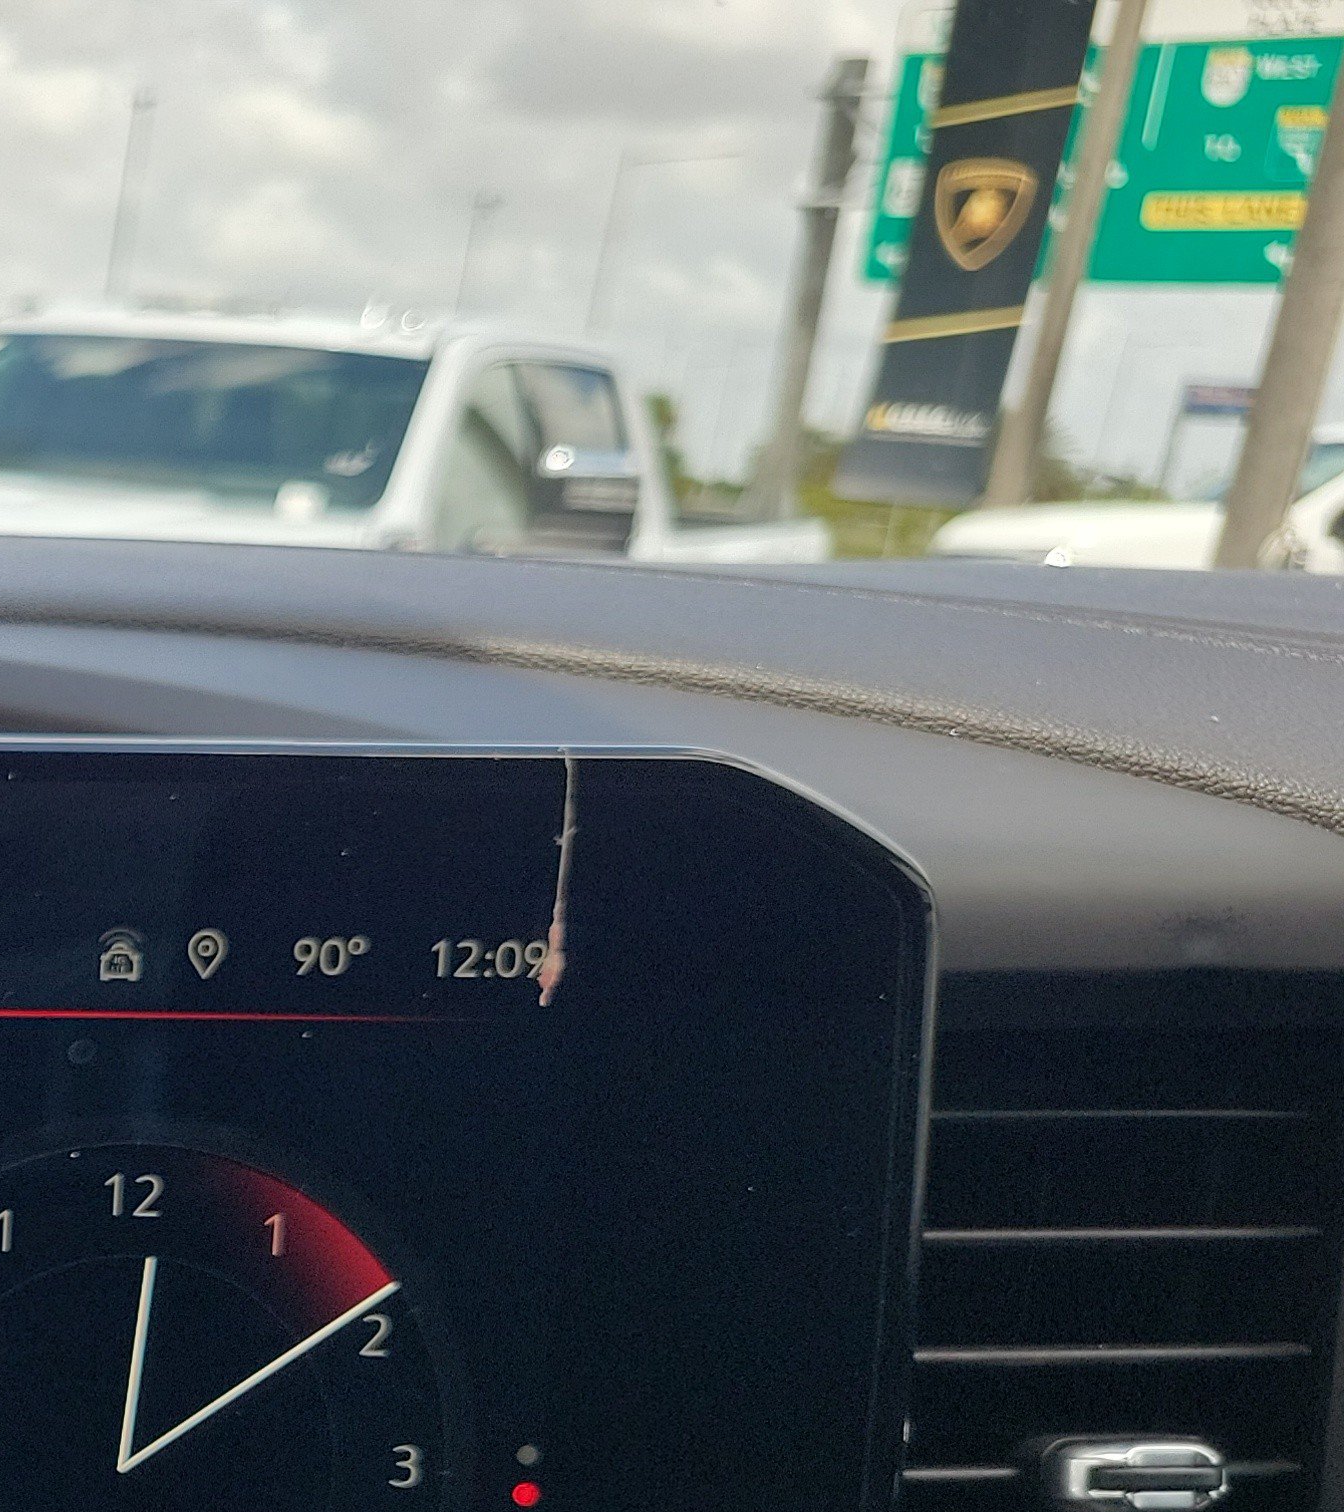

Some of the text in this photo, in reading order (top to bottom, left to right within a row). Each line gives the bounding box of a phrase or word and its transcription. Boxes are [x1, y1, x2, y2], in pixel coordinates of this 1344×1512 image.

[293, 936, 370, 976] 90°
[431, 939, 549, 978] 12:09
[104, 1173, 163, 1218] 12
[263, 1214, 286, 1256] 1
[359, 1314, 390, 1358] 2
[389, 1444, 424, 1488] 3
